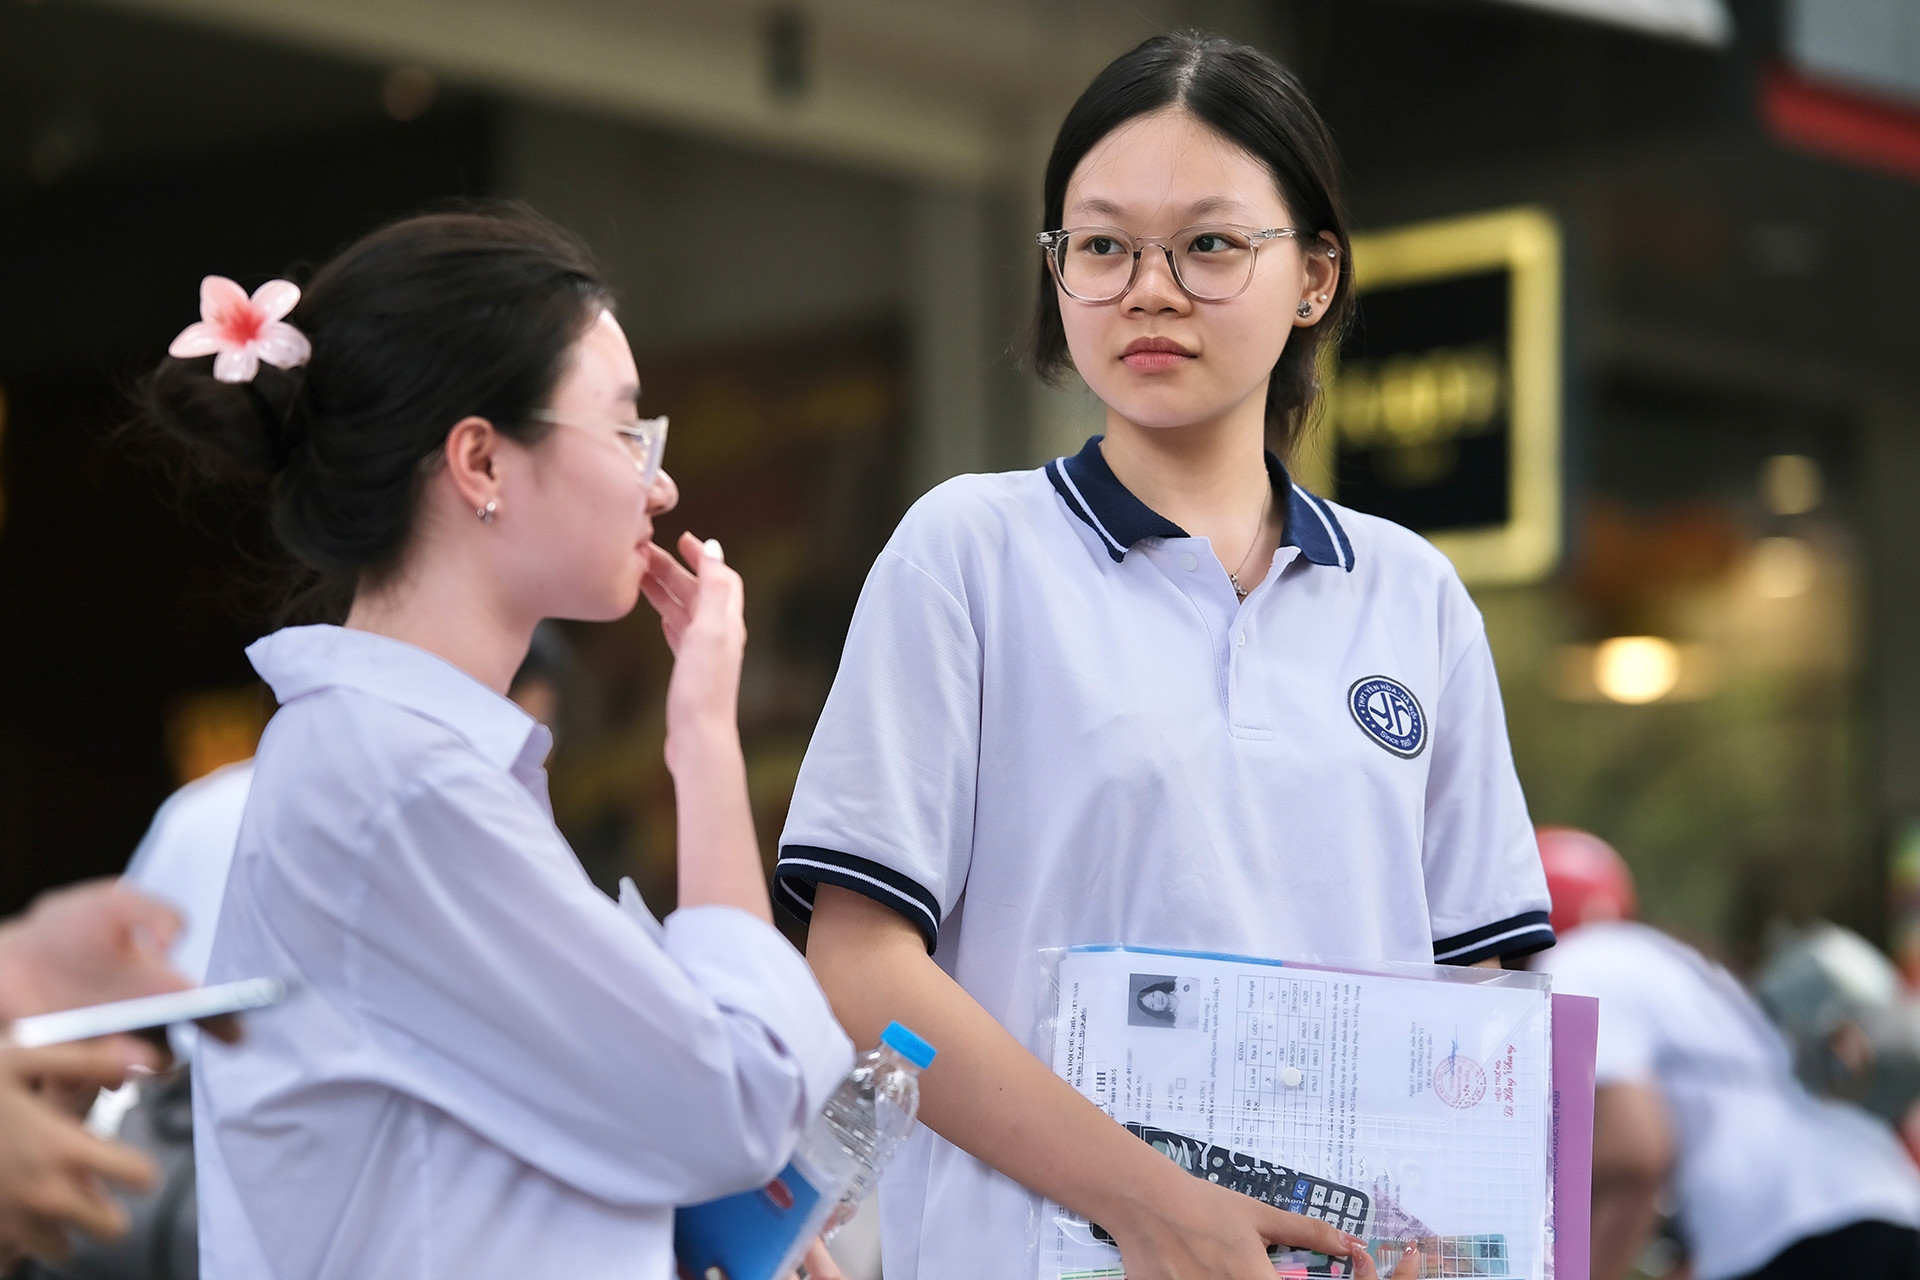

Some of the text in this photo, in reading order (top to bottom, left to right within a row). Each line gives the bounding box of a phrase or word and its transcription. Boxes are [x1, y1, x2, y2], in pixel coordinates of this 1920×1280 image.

[1364, 684, 1380, 694] YÊN
[1380, 683, 1397, 694] HÒA
[1380, 730, 1399, 745] Since
[1269, 992, 1274, 1000] N1
[1096, 1071, 1106, 1095] THI
[1296, 1184, 1306, 1196] AC
